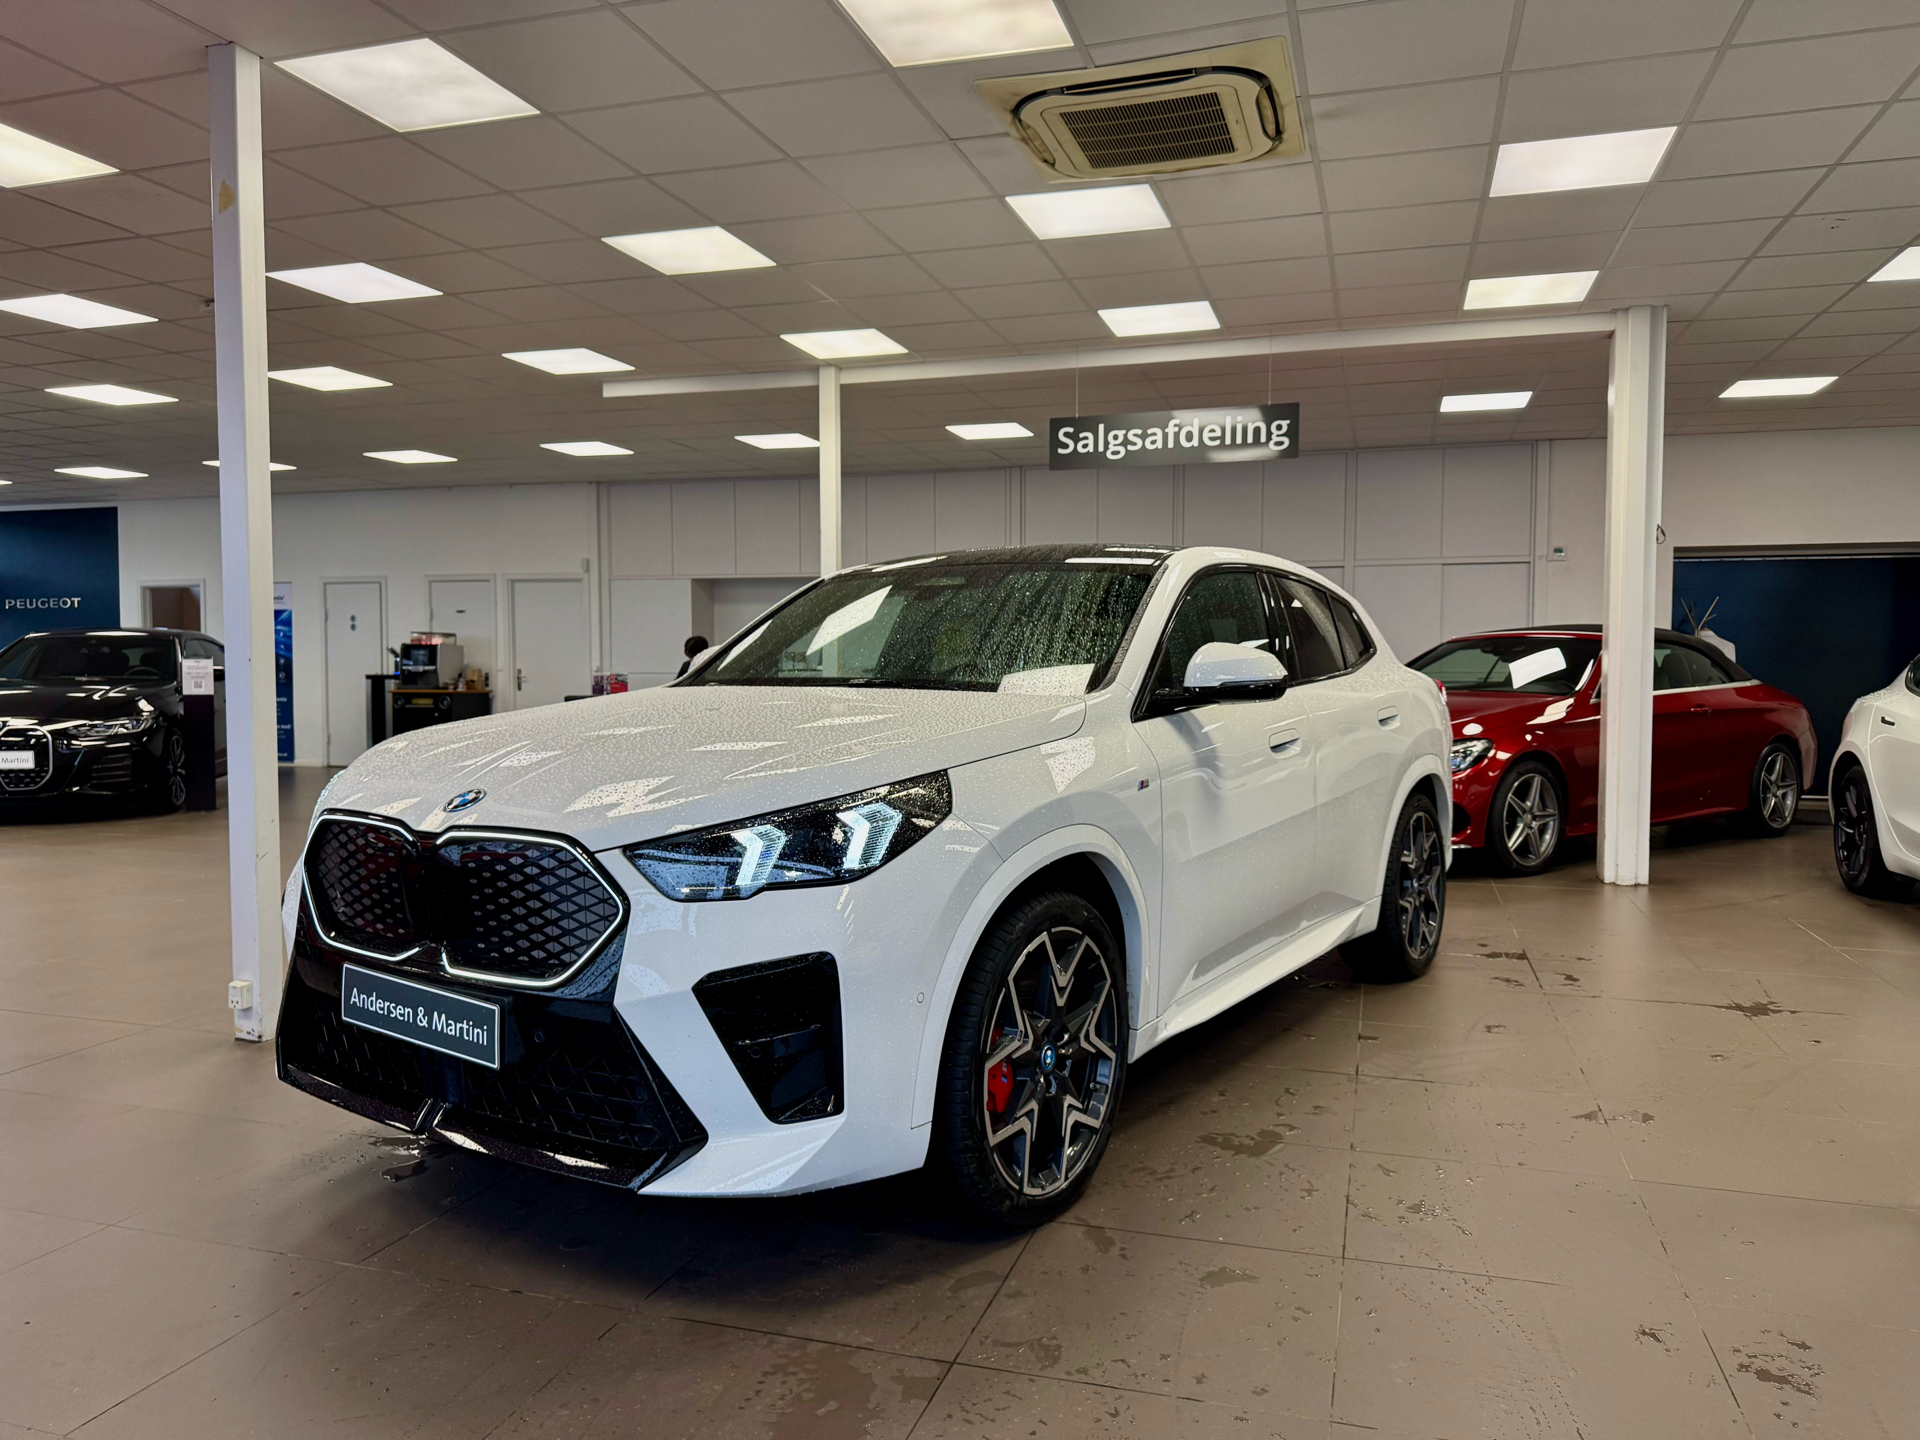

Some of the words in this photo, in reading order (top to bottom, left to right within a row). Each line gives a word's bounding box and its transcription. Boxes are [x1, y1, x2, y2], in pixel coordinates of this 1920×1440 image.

[1057, 415, 1291, 460] Salgsafdeling
[5, 597, 82, 610] PEUGEOT
[350, 987, 413, 1023] Andersen
[416, 1006, 428, 1028] &
[432, 1010, 488, 1046] Martini
